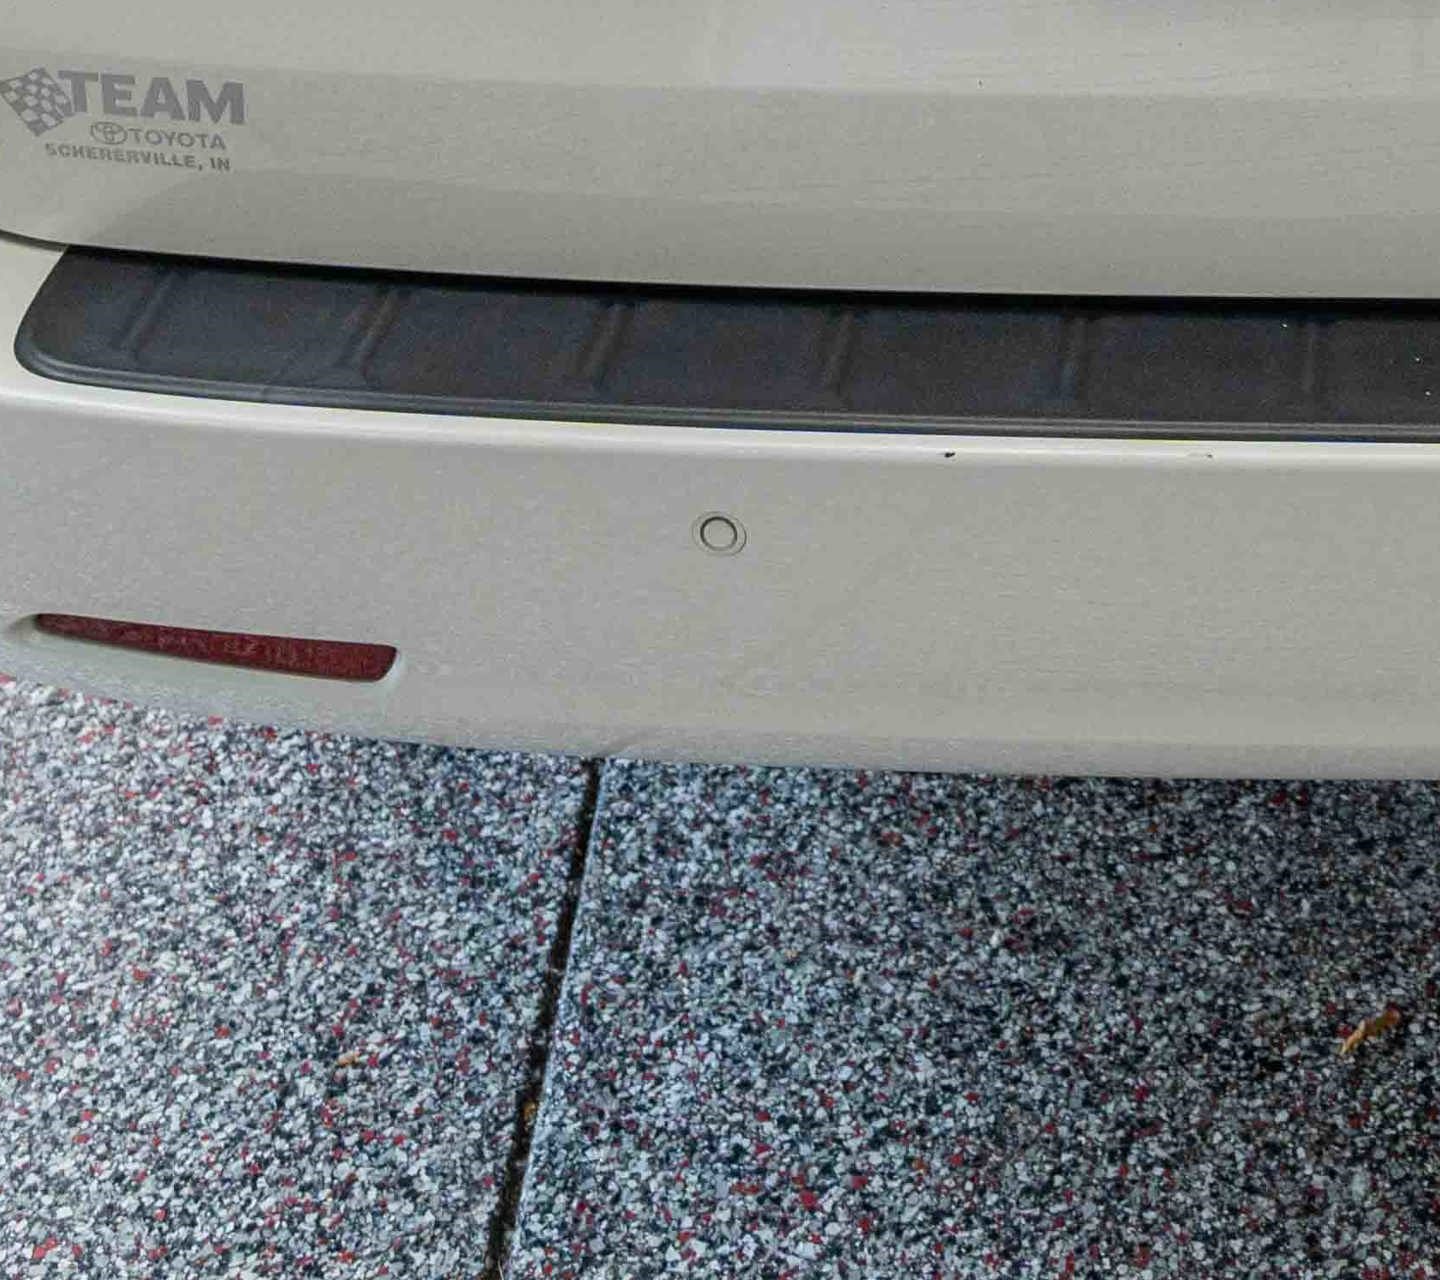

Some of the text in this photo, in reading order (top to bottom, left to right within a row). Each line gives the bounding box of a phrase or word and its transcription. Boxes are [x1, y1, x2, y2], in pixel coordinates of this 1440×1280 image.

[58, 69, 246, 125] TEAM
[126, 127, 227, 151] TOYOTA
[44, 141, 232, 172] SCHERERVILLE, IN
